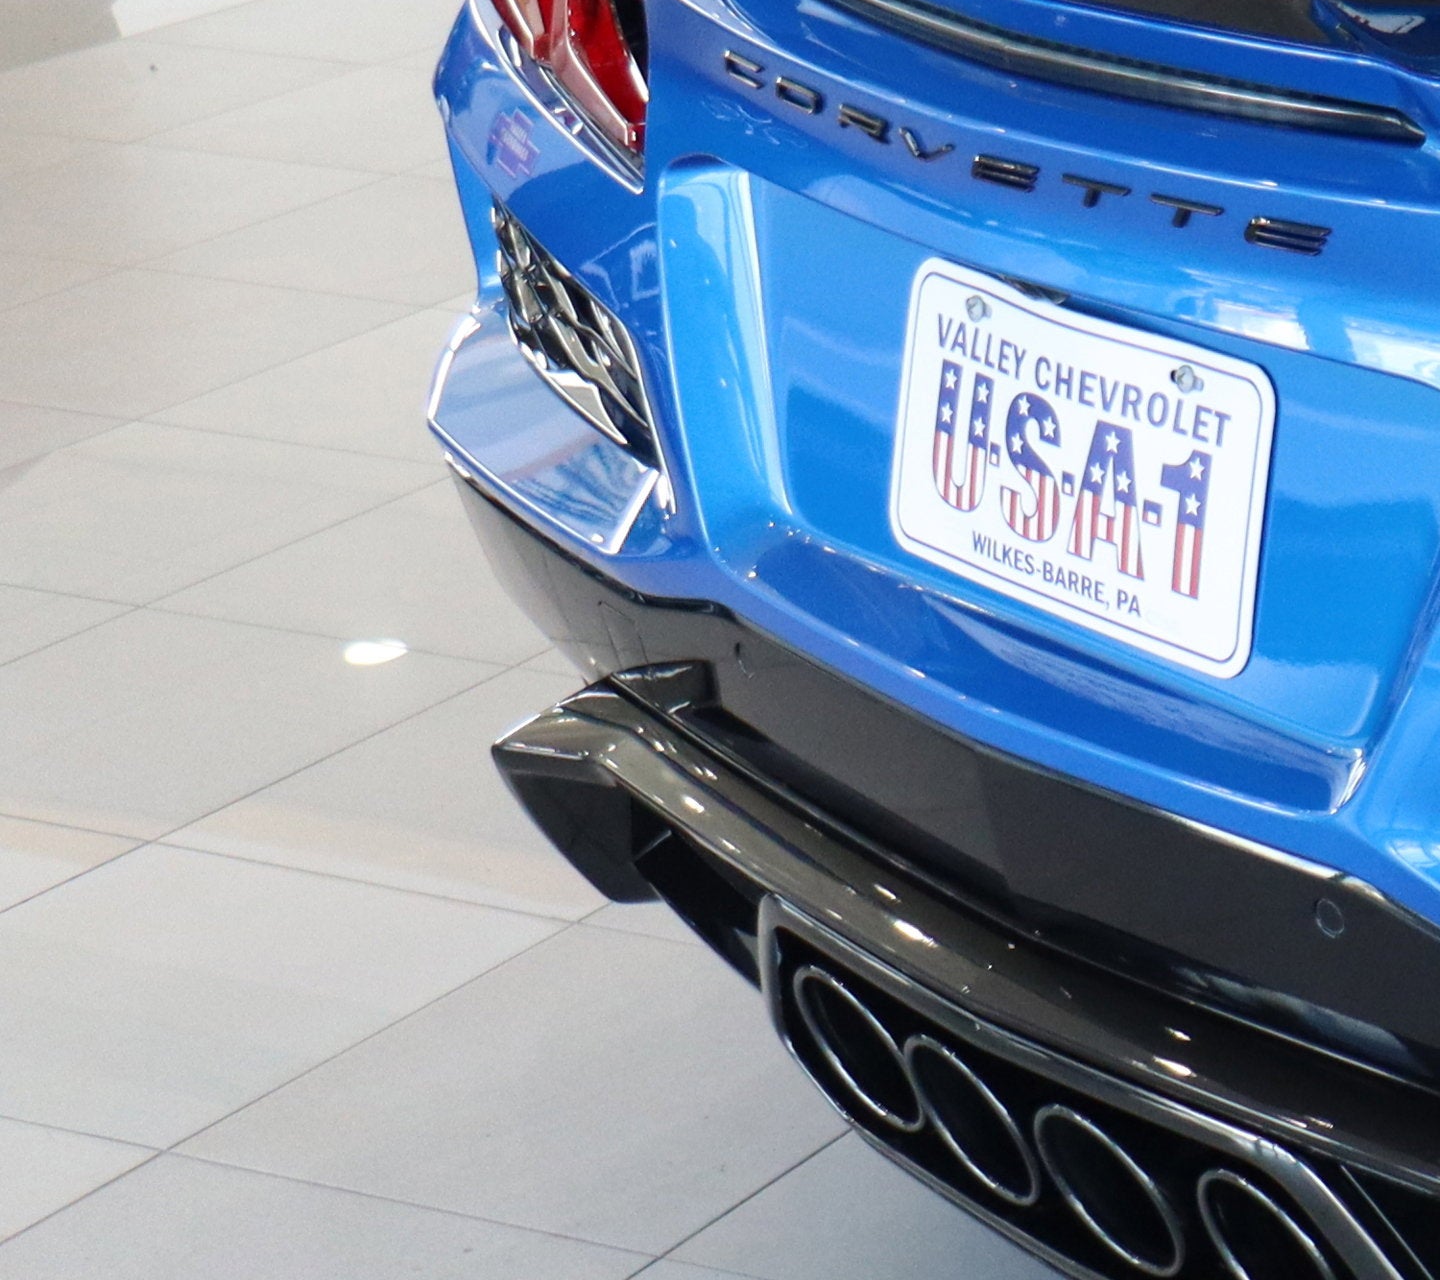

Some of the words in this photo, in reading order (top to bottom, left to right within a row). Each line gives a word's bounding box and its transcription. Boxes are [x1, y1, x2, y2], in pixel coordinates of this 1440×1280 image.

[724, 49, 1332, 256] CORVETTE
[938, 313, 1027, 381] VALLEY
[1034, 356, 1232, 448] CHEVROLET
[971, 529, 1111, 610] WILKES-BARRE,
[1116, 588, 1142, 618] PA
